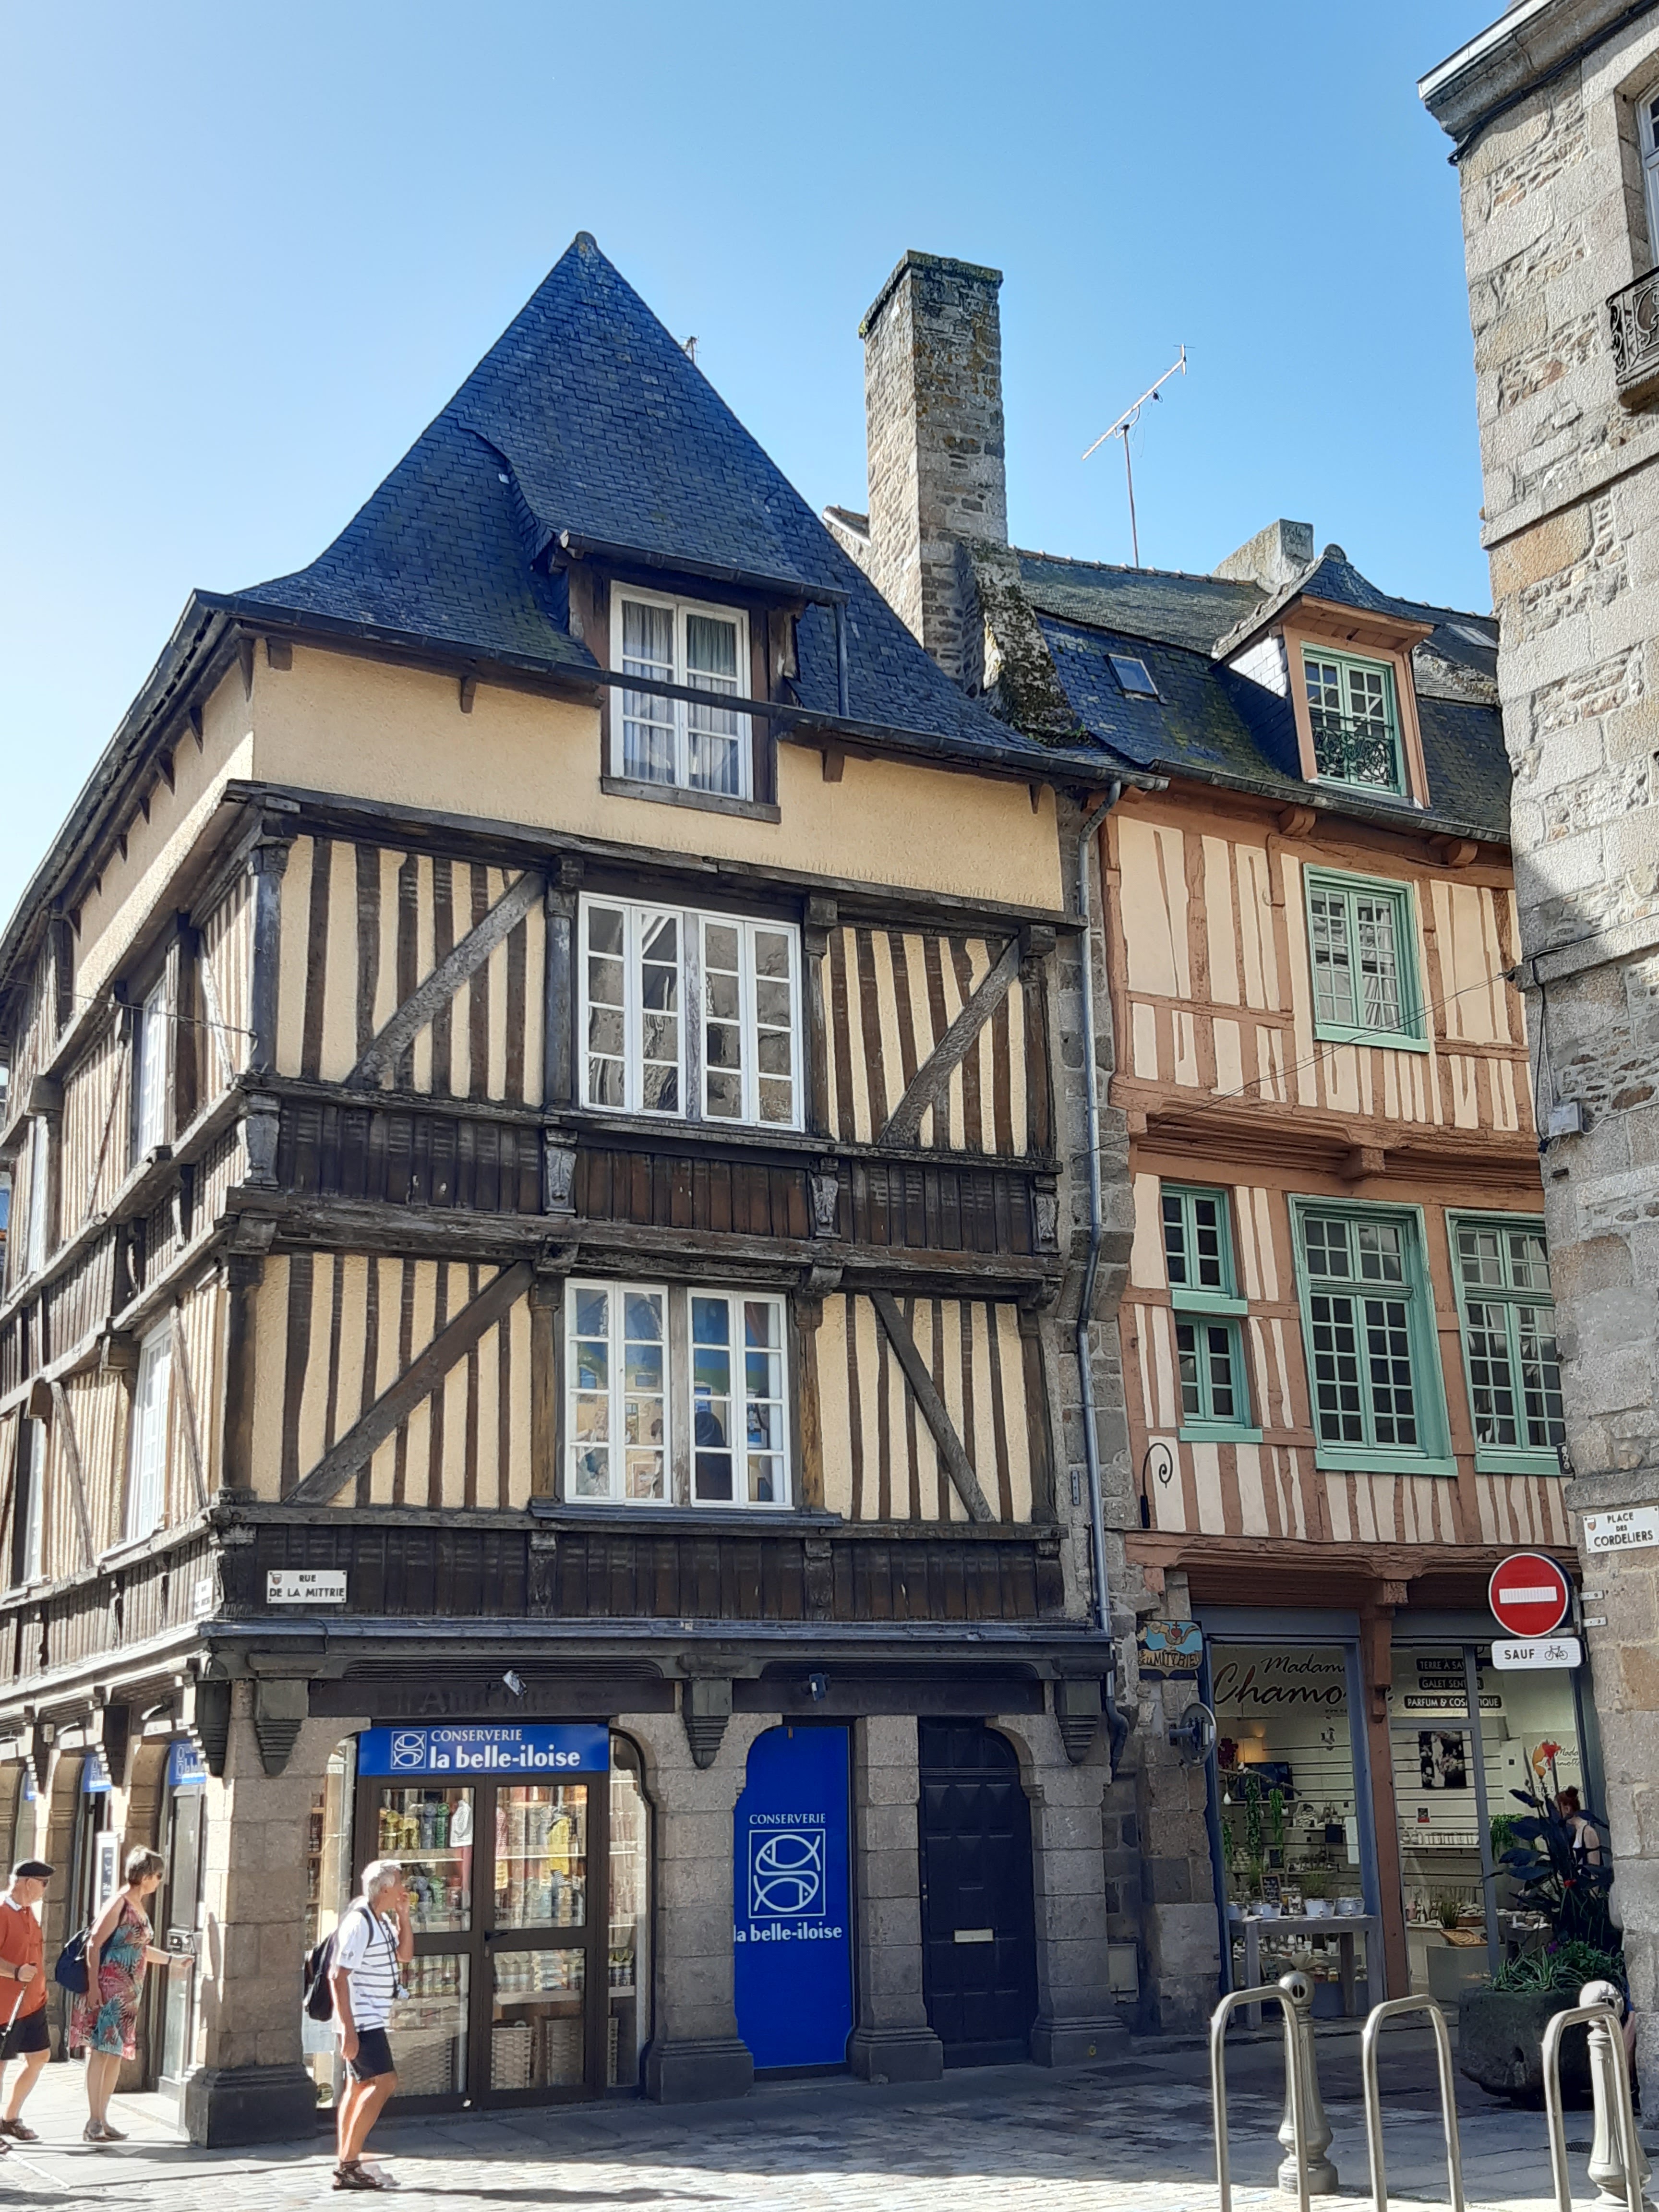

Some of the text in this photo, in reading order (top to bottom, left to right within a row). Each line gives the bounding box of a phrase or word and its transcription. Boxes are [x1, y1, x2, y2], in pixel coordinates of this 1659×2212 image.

[1607, 1512, 1634, 1524] PLACE
[1594, 1530, 1653, 1547] CORDELIERS
[269, 1588, 345, 1598] DE LA MITTRIE
[1504, 1648, 1535, 1660] SAUF
[1260, 1653, 1345, 1674] Madam
[1420, 1661, 1442, 1670] TERRE
[1214, 1662, 1394, 1705] Chamo
[1422, 1679, 1482, 1689] GALET SENTR
[1407, 1697, 1438, 1707] PARFUM
[1440, 1697, 1447, 1707] &
[431, 1729, 522, 1742] CONSERVERIE
[430, 1744, 580, 1768] la belle-iloise
[1555, 1746, 1579, 1756] Mada
[749, 1813, 826, 1825] CONSERVERIE
[750, 1921, 842, 1941] belle-iloise
